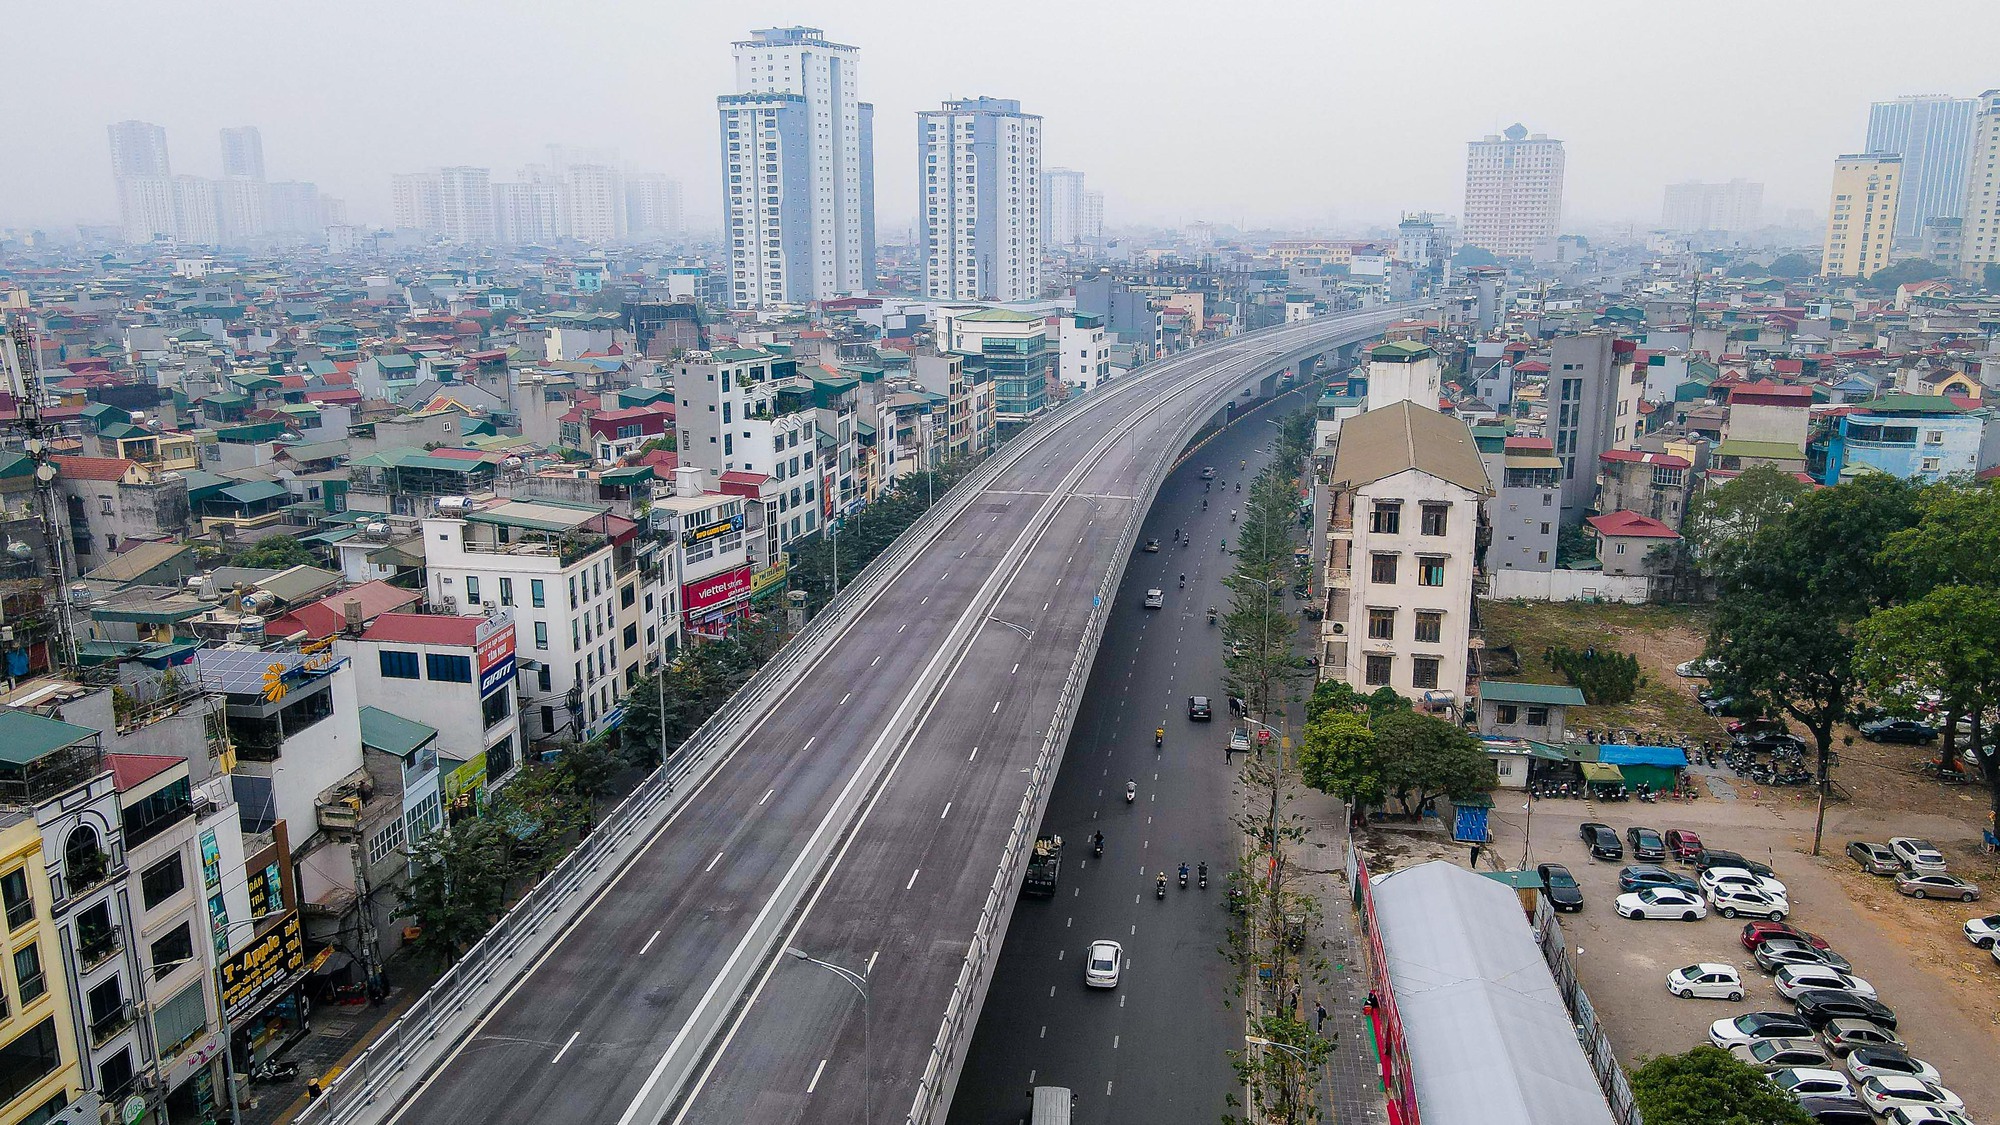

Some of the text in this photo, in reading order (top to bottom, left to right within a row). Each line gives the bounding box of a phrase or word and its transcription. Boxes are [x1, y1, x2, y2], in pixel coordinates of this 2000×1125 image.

[698, 582, 727, 599] viettel
[727, 579, 743, 589] store
[482, 660, 514, 690] GIANT
[251, 889, 265, 907] TRẢ
[127, 1102, 143, 1119] das
